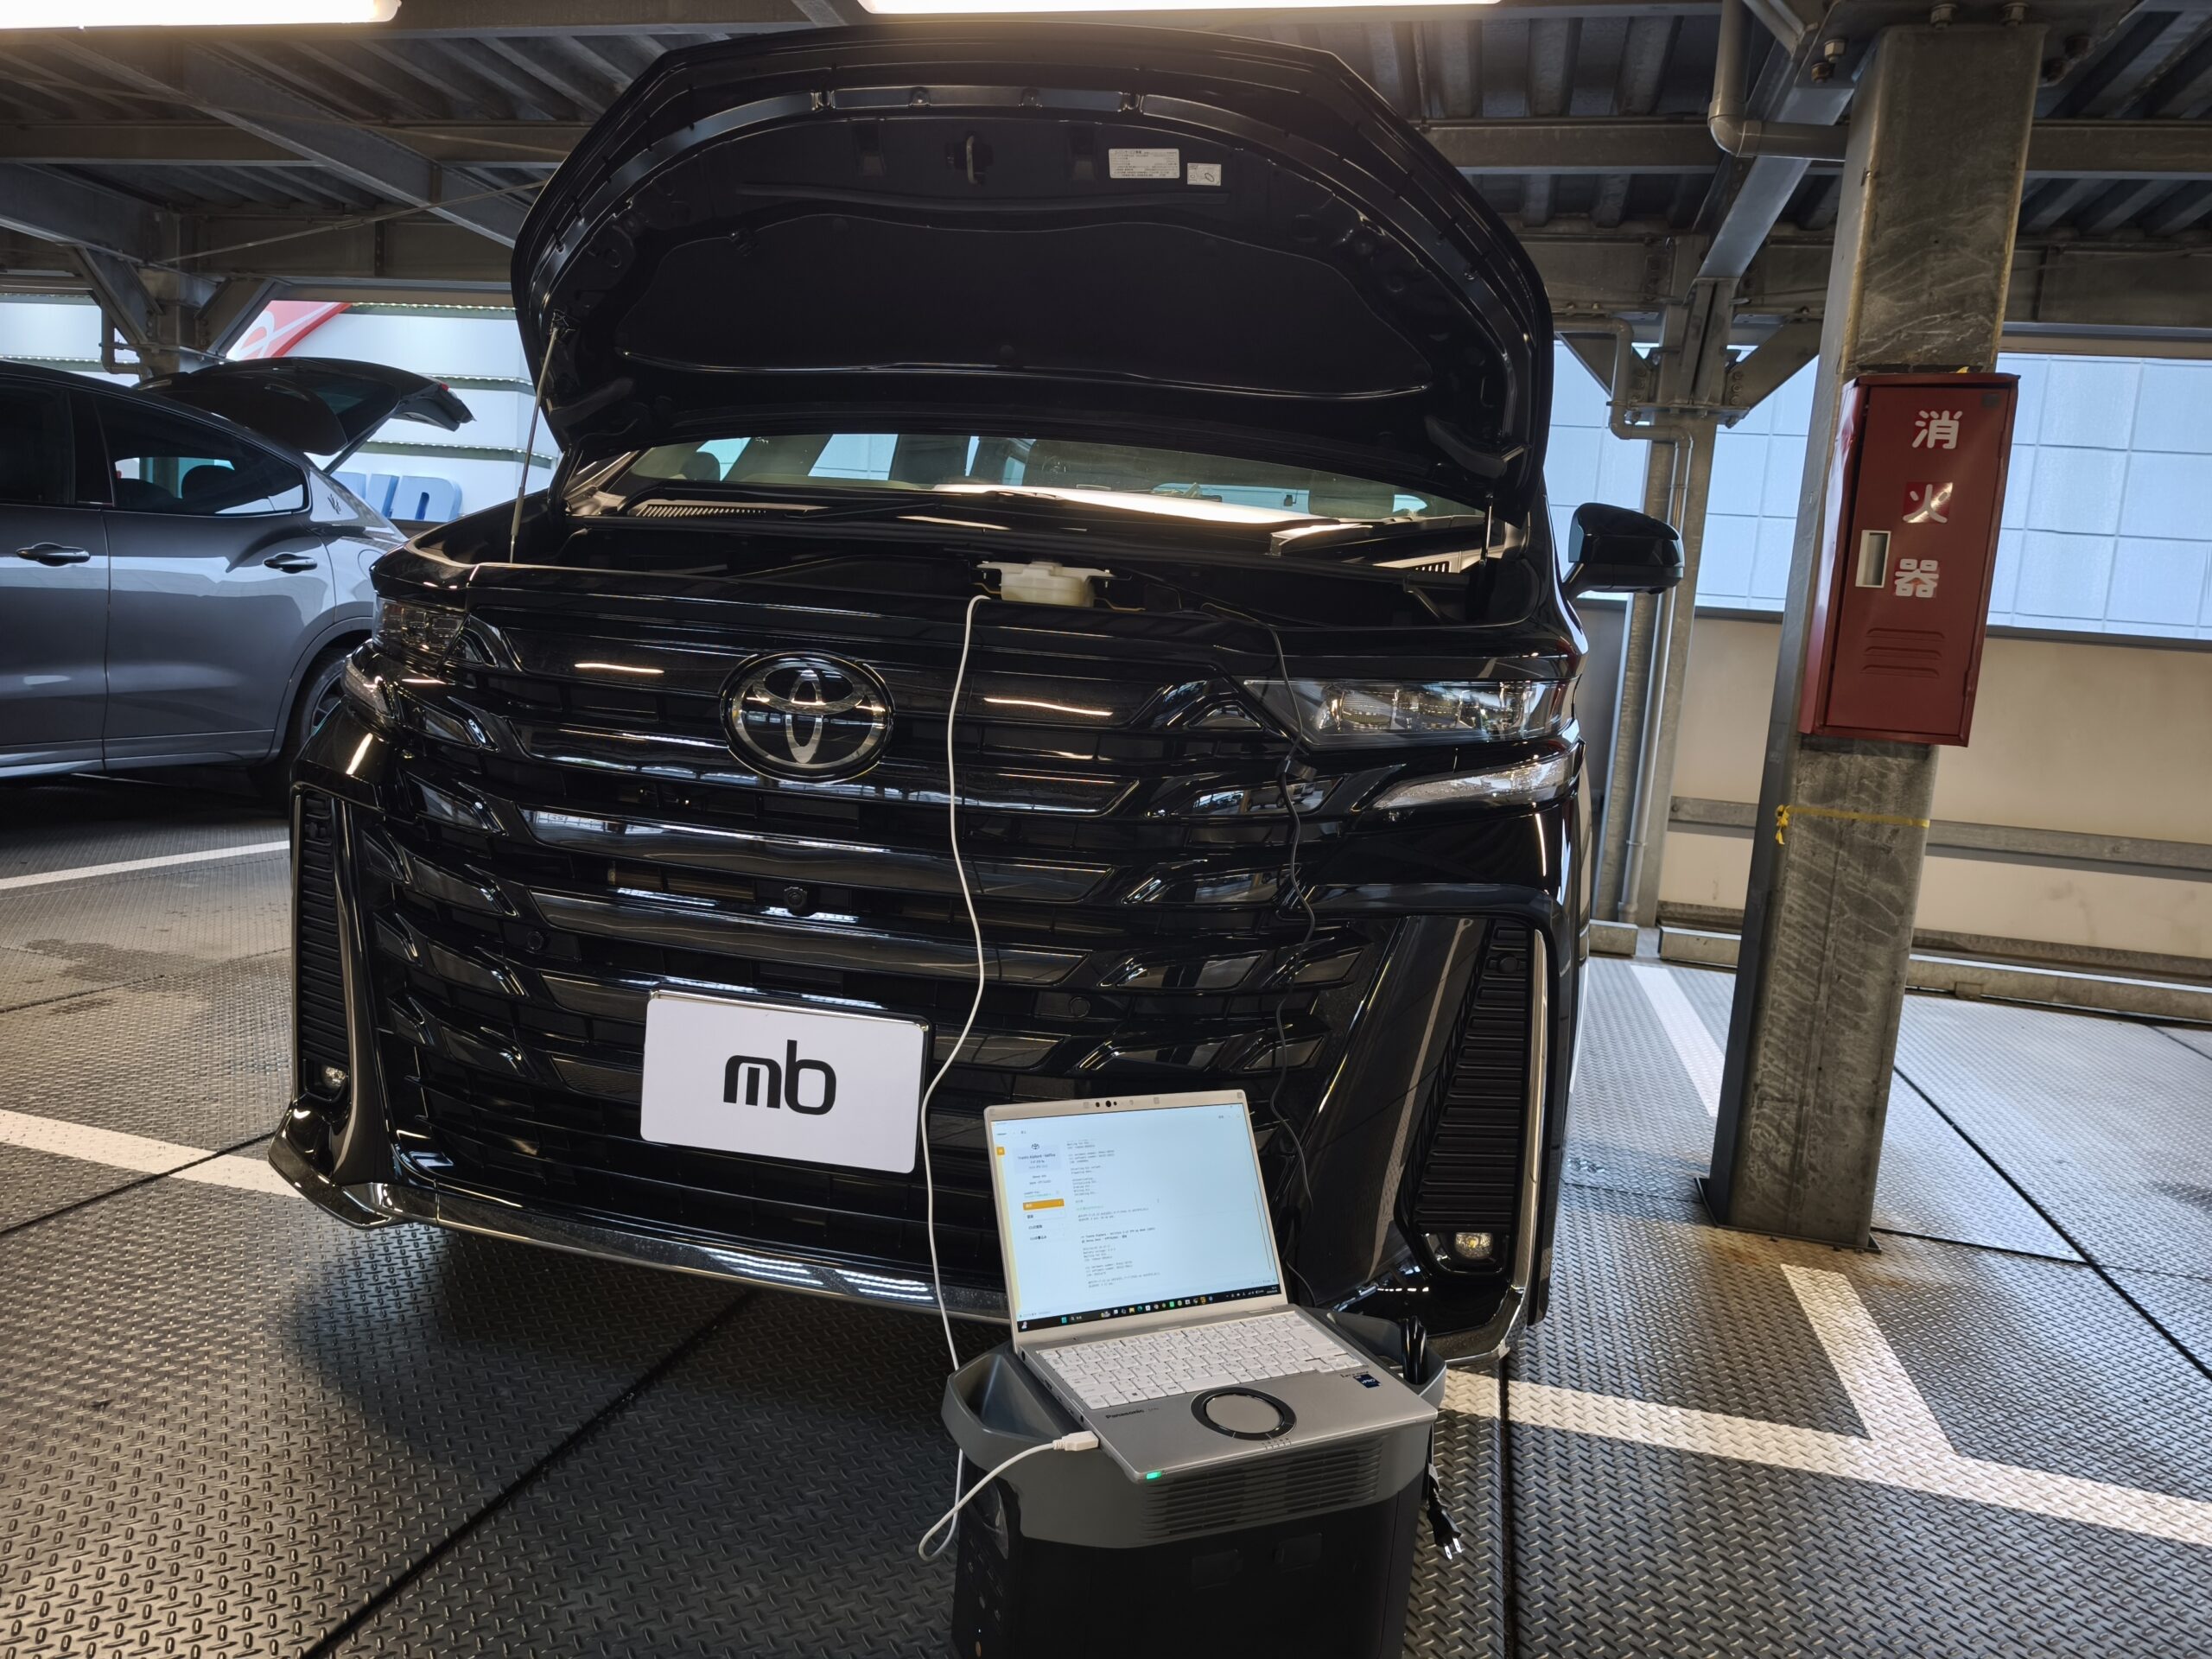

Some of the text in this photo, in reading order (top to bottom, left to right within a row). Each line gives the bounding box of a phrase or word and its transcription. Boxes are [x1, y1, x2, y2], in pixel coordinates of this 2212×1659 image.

[1894, 410, 1963, 599] 消火器
[723, 1039, 836, 1116] mb
